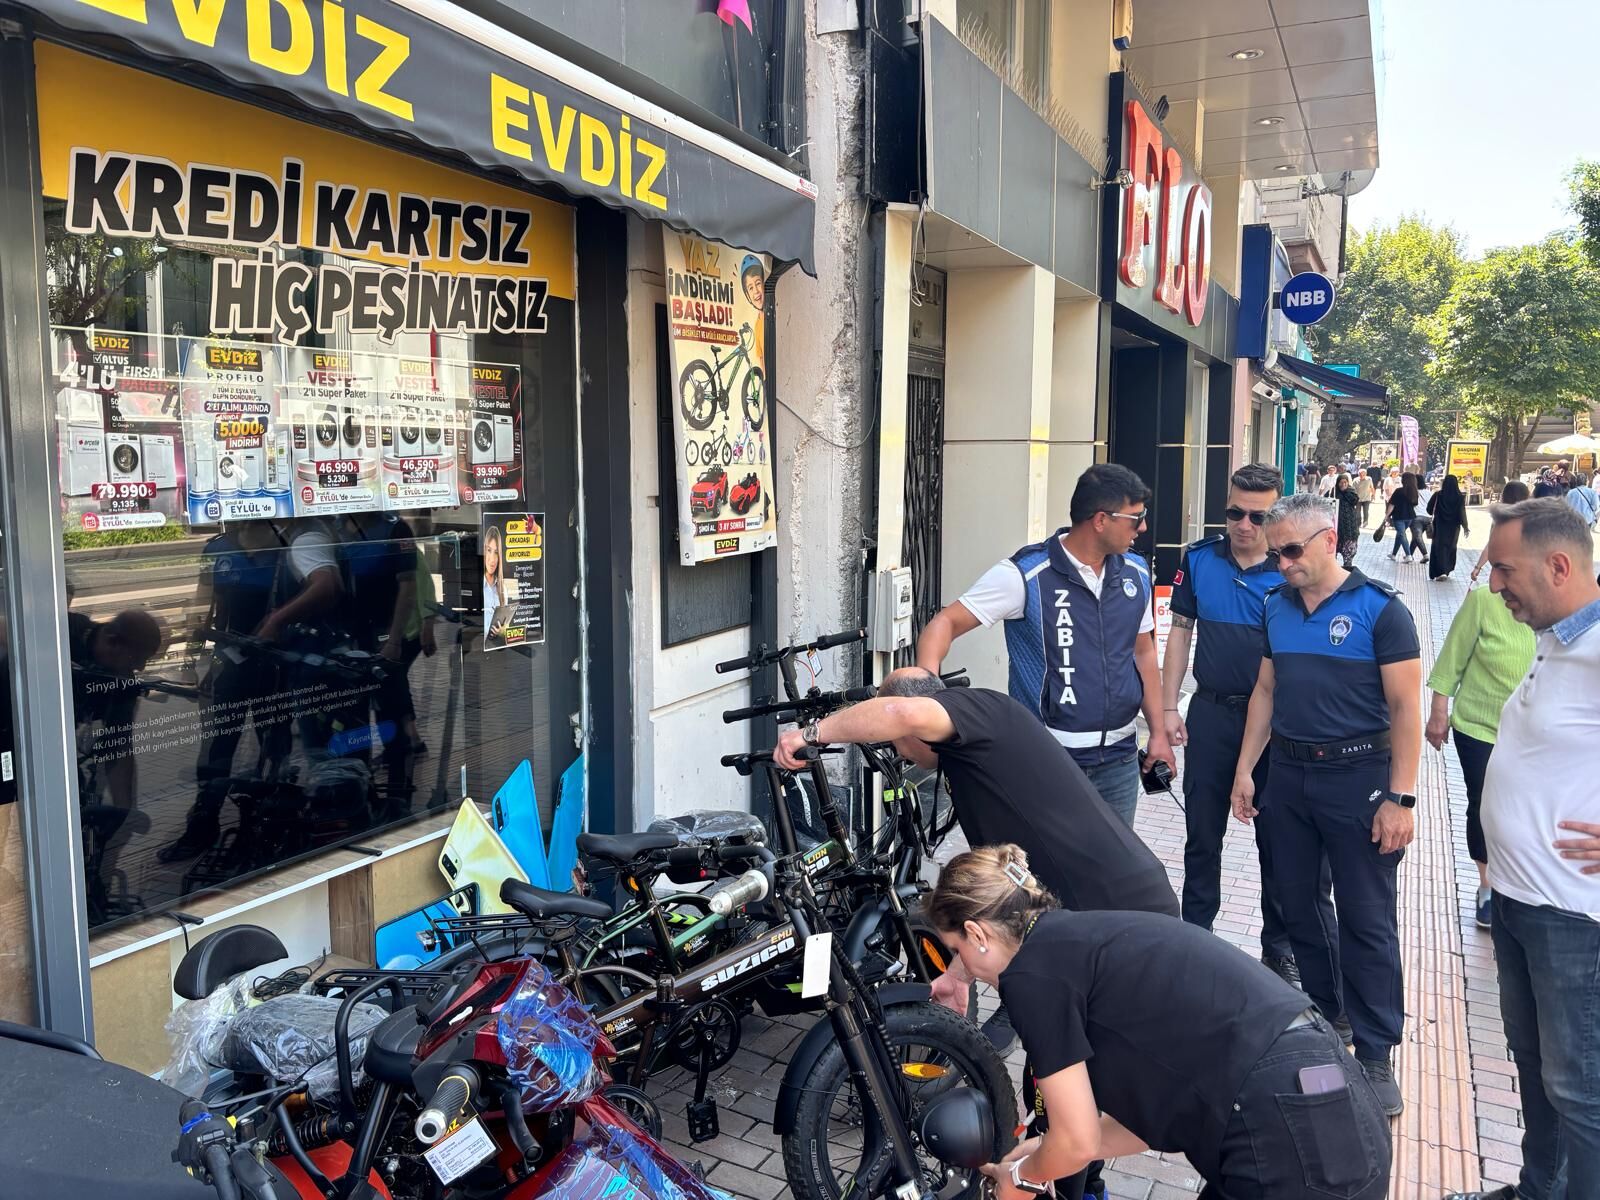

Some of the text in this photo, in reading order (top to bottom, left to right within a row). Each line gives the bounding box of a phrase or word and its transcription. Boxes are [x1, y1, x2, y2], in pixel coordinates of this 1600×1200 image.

[74, 0, 414, 121] VDİZ
[489, 72, 668, 211] EVDİZ
[68, 148, 531, 267] KREDİ KARTSIZ
[679, 235, 720, 279] YAZ
[211, 250, 548, 344] HİÇ PEŞİNATSIZ
[1286, 289, 1326, 308] NBB
[672, 299, 733, 327] BAŞLADI!
[102, 355, 129, 365] ALTUS
[123, 366, 165, 379] FIRSAT
[318, 388, 342, 400] Süper
[344, 388, 367, 398] Paket
[230, 502, 260, 513] EYLÜL
[730, 521, 744, 530] SONRA
[1158, 606, 1165, 616] 6
[1054, 589, 1077, 705] ZABITA
[86, 678, 119, 694] Sinyal
[92, 728, 116, 738] HDMI
[1342, 744, 1372, 754] ZABITA
[770, 928, 793, 944] EMU
